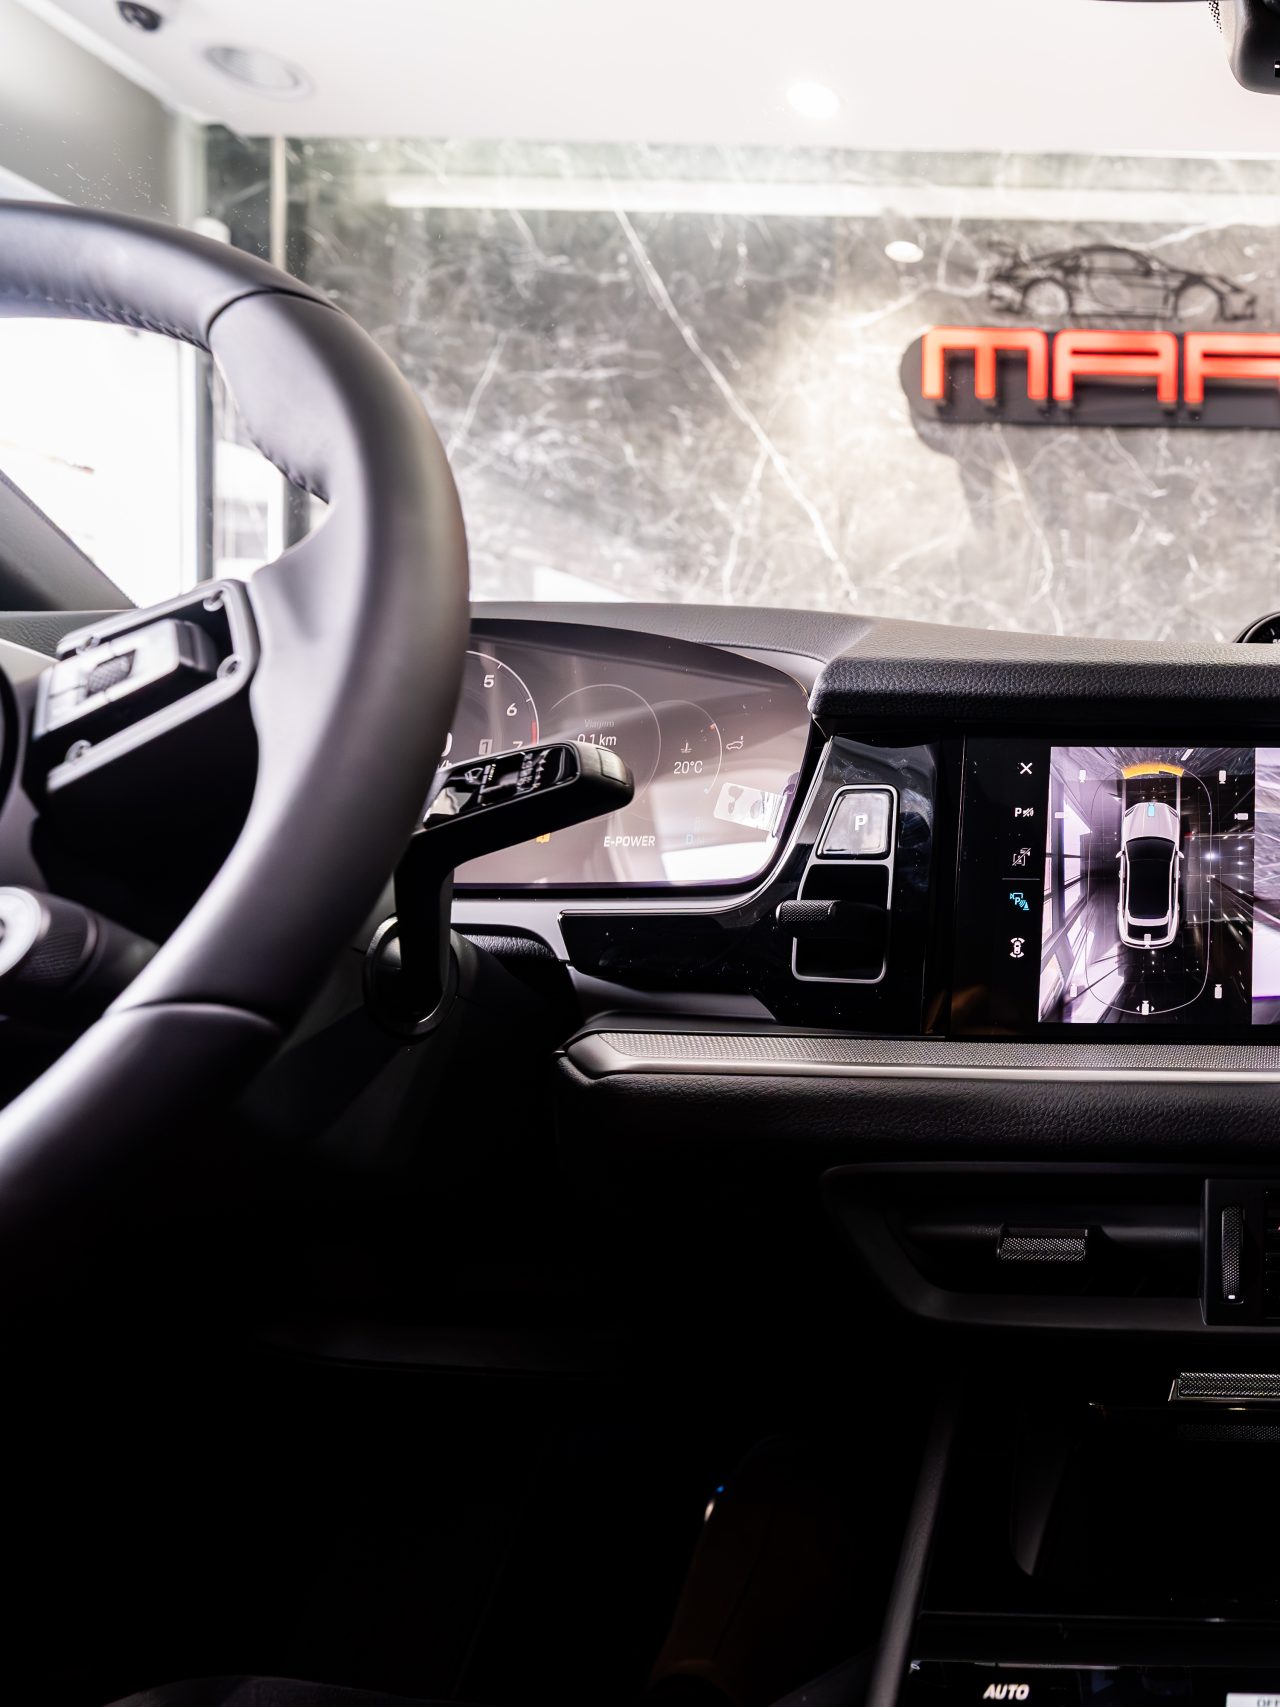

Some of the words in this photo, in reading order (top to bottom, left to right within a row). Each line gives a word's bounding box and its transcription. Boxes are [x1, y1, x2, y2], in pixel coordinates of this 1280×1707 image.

[483, 674, 495, 688] 5
[506, 702, 518, 717] 6
[599, 733, 617, 746] km
[673, 760, 703, 775] 20°C
[854, 813, 868, 831] P
[603, 835, 656, 848] E-POWER
[982, 1683, 1030, 1700] AUTO
